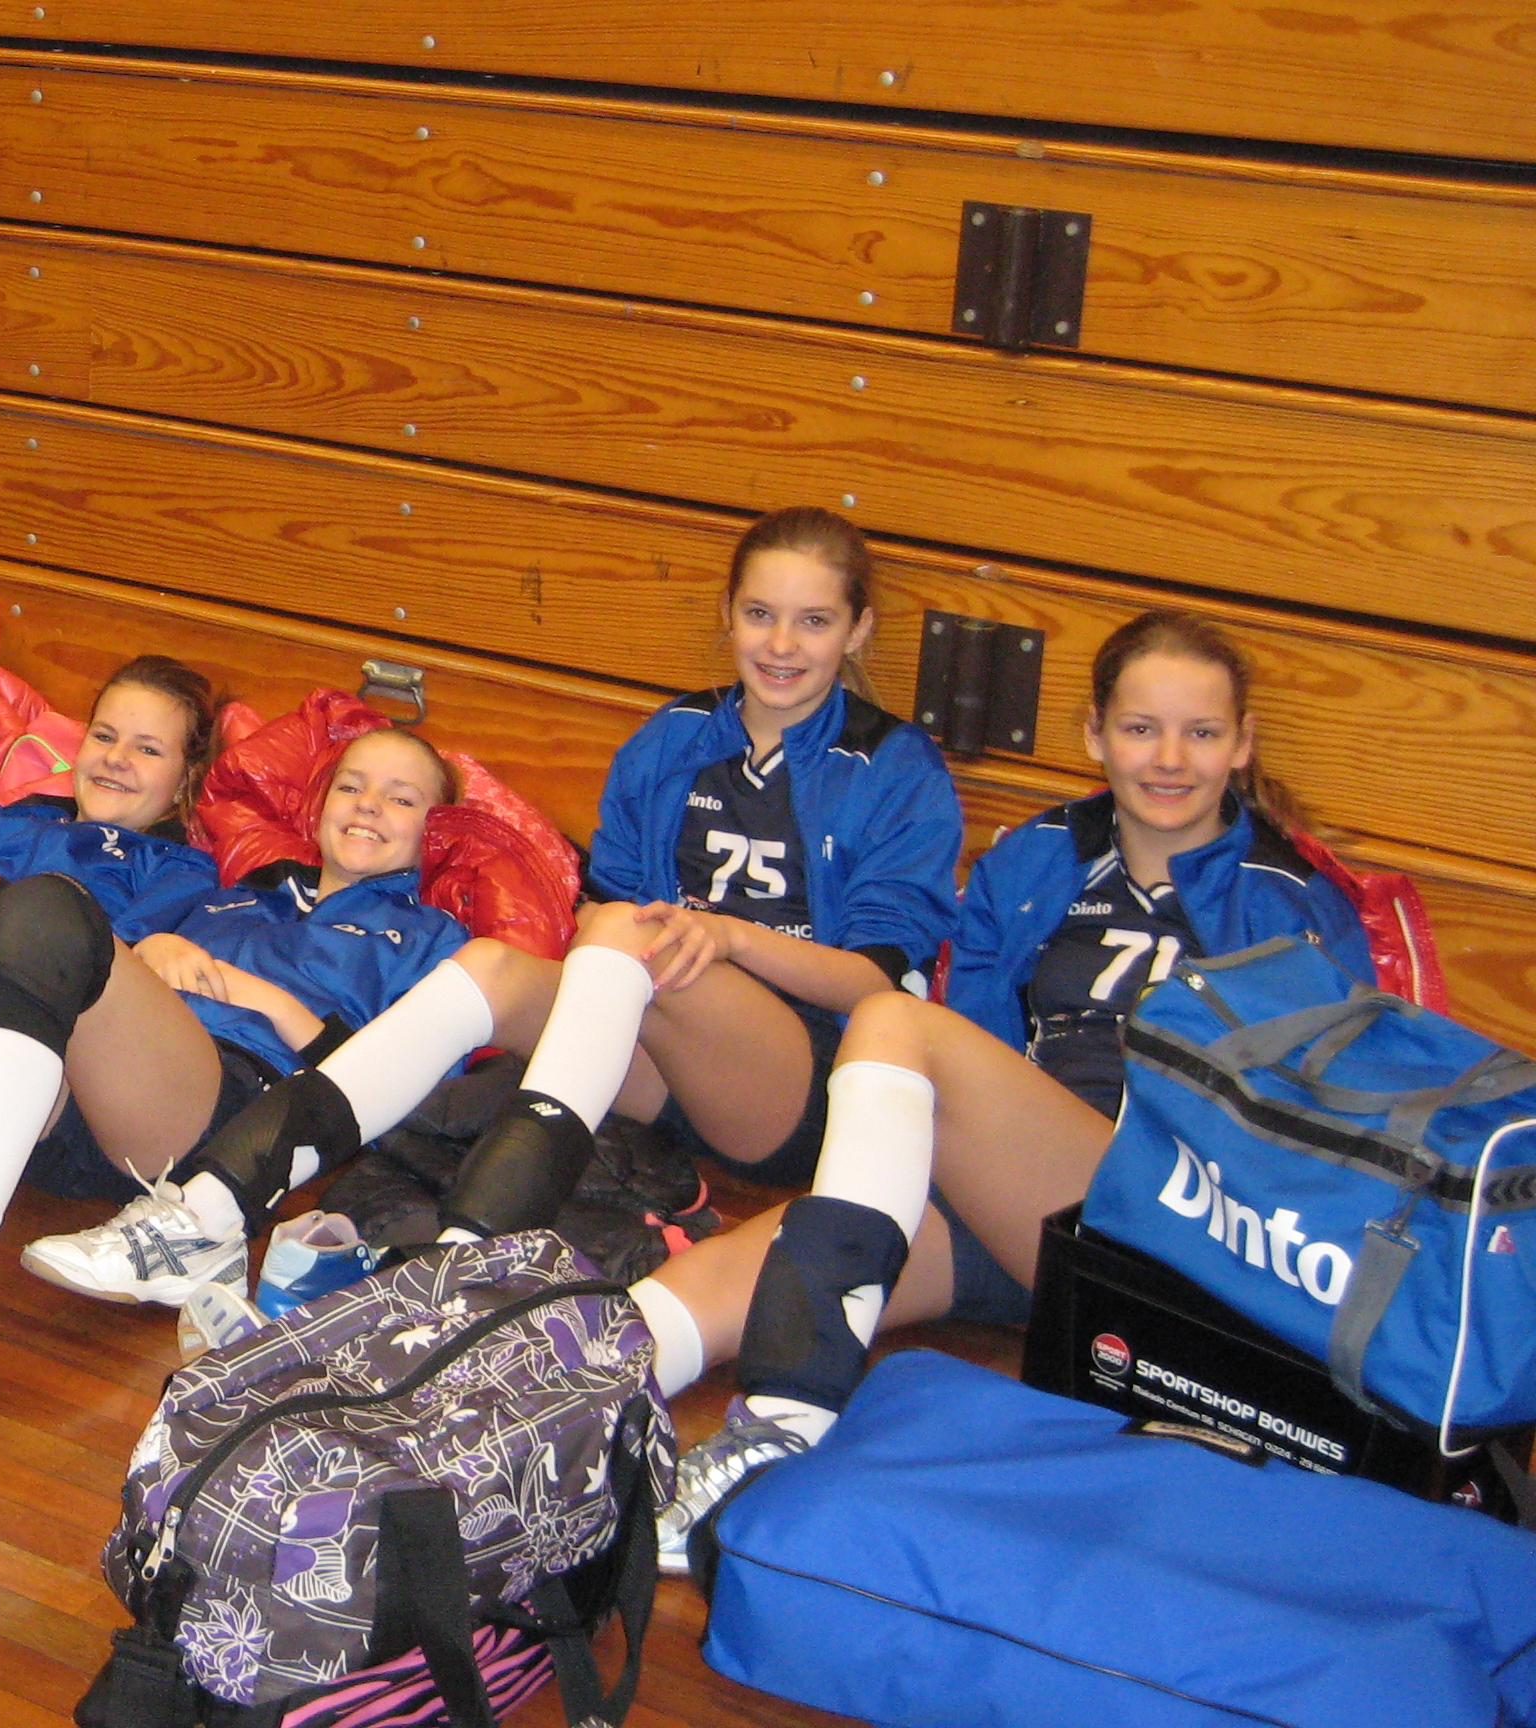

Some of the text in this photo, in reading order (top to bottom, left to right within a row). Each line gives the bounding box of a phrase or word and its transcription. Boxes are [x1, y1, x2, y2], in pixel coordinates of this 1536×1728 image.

[705, 829, 787, 902] 75
[1067, 901, 1113, 916] Dinto
[1089, 928, 1180, 1000] 71
[1158, 1135, 1352, 1305] Dinto
[1097, 1351, 1123, 1366] 2000
[1135, 1359, 1257, 1420] SPORTSHOP
[1257, 1410, 1345, 1461] BOUWES
